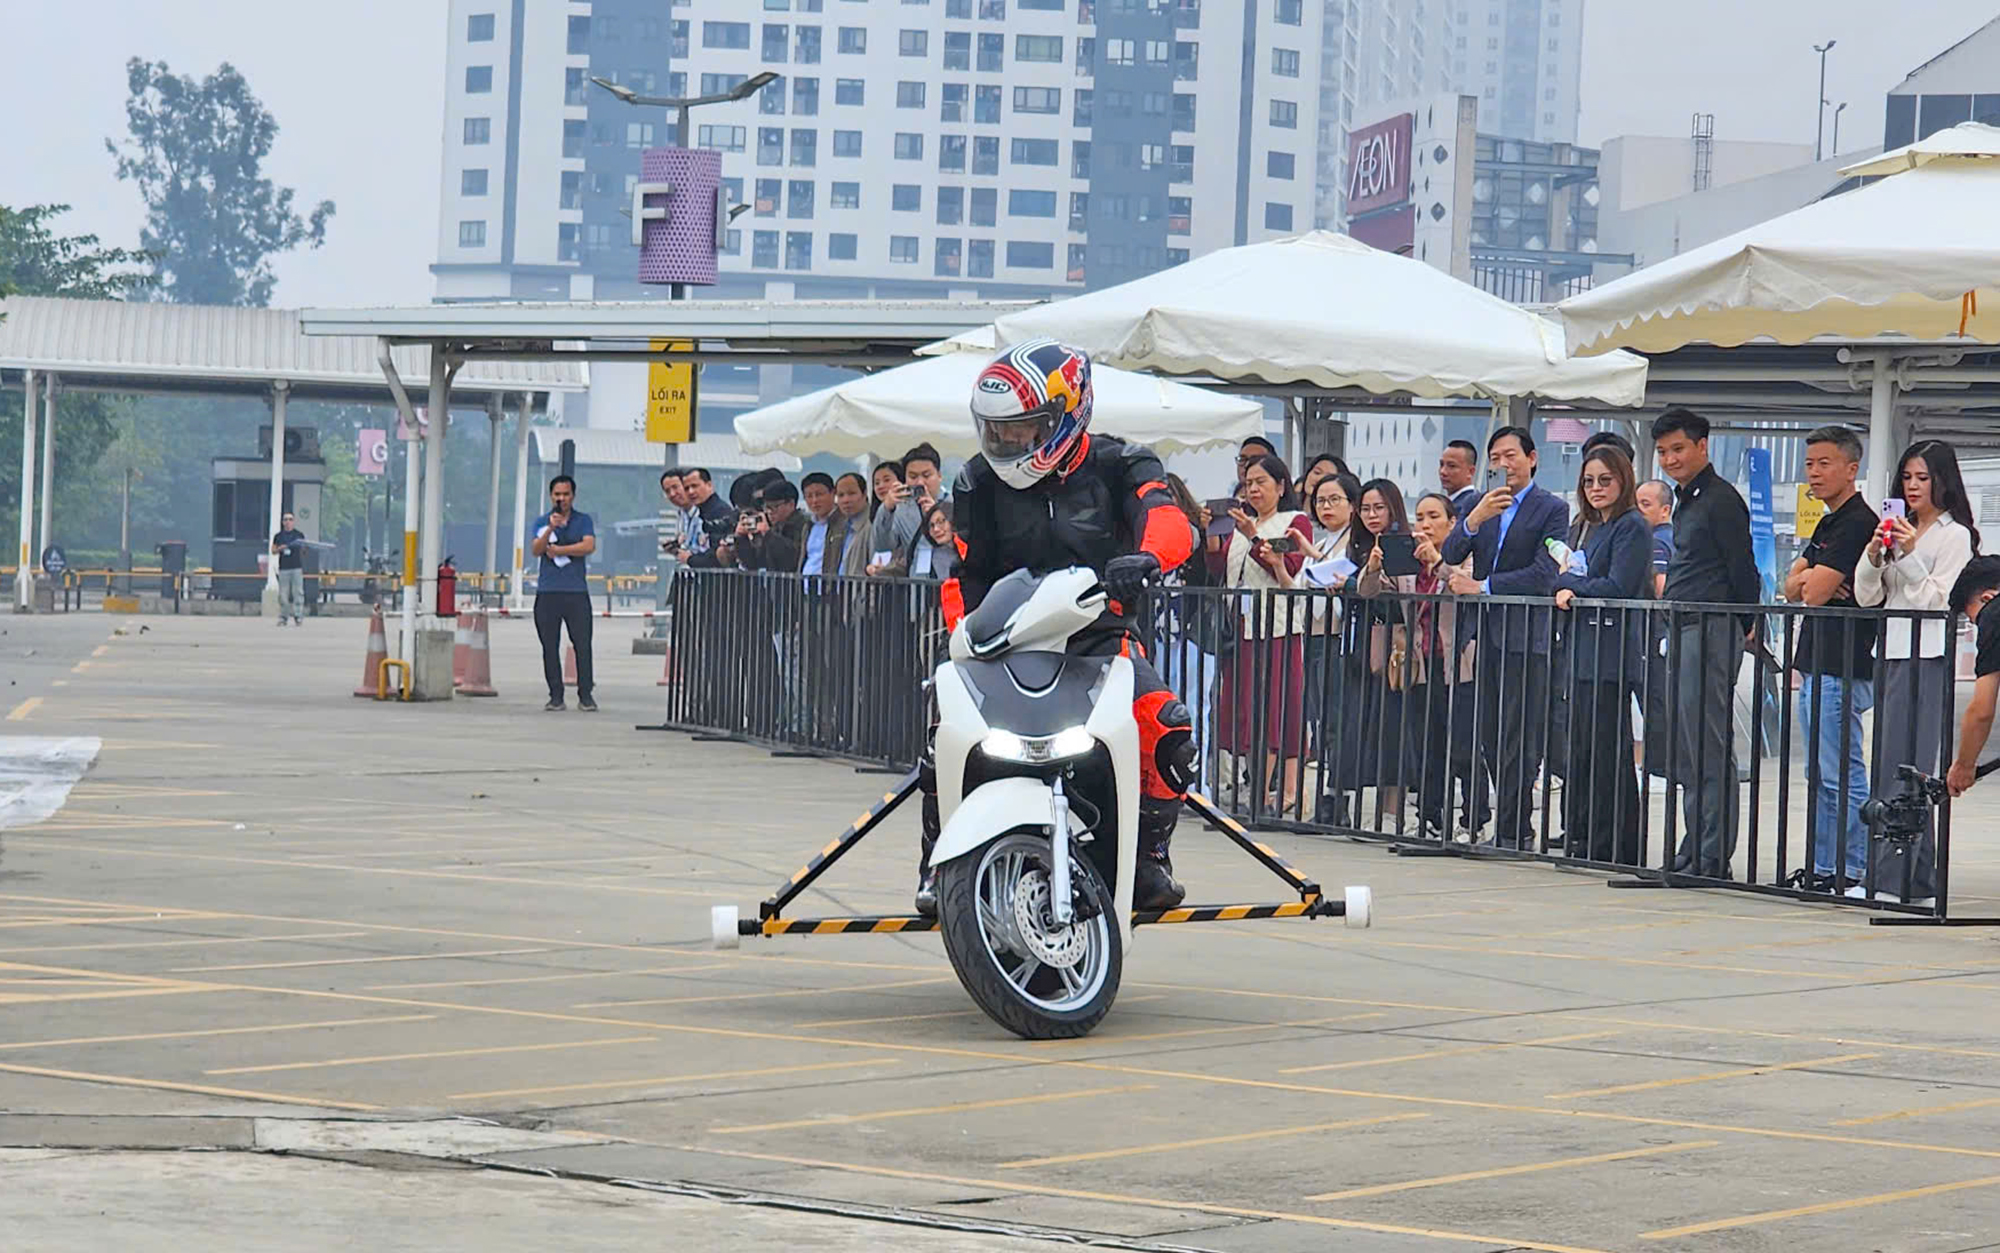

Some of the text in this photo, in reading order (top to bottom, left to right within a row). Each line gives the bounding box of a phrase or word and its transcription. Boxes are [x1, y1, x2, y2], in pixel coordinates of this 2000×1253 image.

[632, 183, 673, 246] F
[671, 390, 686, 401] RA
[659, 406, 677, 414] EXIT
[372, 442, 388, 462] G
